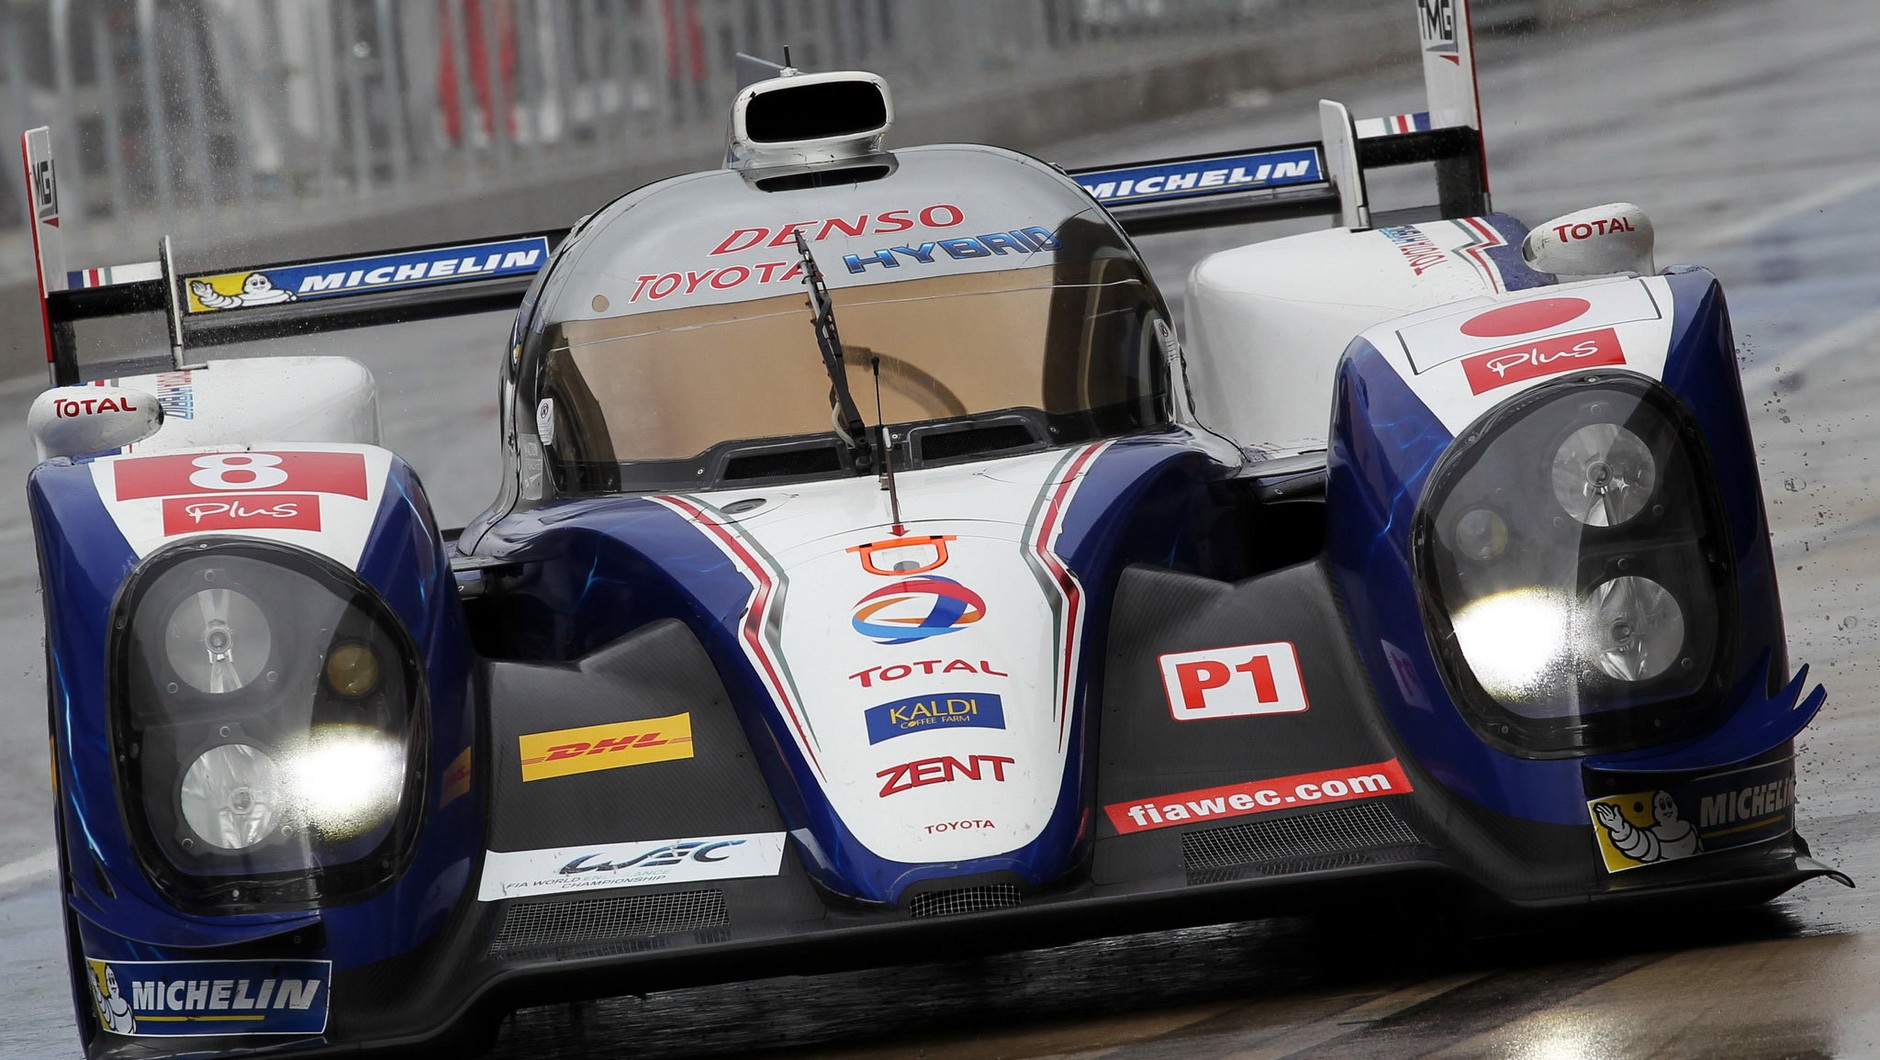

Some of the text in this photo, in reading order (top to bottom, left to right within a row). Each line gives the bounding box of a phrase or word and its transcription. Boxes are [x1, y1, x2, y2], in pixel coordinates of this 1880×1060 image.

[1083, 160, 1310, 198] MICHELIN
[708, 204, 965, 256] DENSO
[1553, 217, 1635, 242] TOTAL
[842, 226, 1063, 274] HYBRID
[299, 249, 541, 293] MICHELIN
[1486, 340, 1599, 378] Plus
[54, 397, 137, 418] TOTAL
[189, 453, 288, 490] 8
[185, 501, 298, 523] Plus
[849, 659, 1008, 687] TOTAL
[1175, 655, 1279, 709] P1
[889, 699, 977, 724] KALDI
[900, 716, 937, 729] COFFEE
[545, 732, 669, 761] DHL
[876, 755, 1015, 798] ZENT
[1127, 772, 1393, 826] fiawec.com
[924, 819, 996, 834] TOYOTA
[532, 877, 581, 886] WORLD
[561, 875, 666, 889] CHAMPIONSHIP
[132, 979, 321, 1010] MICHELIN
